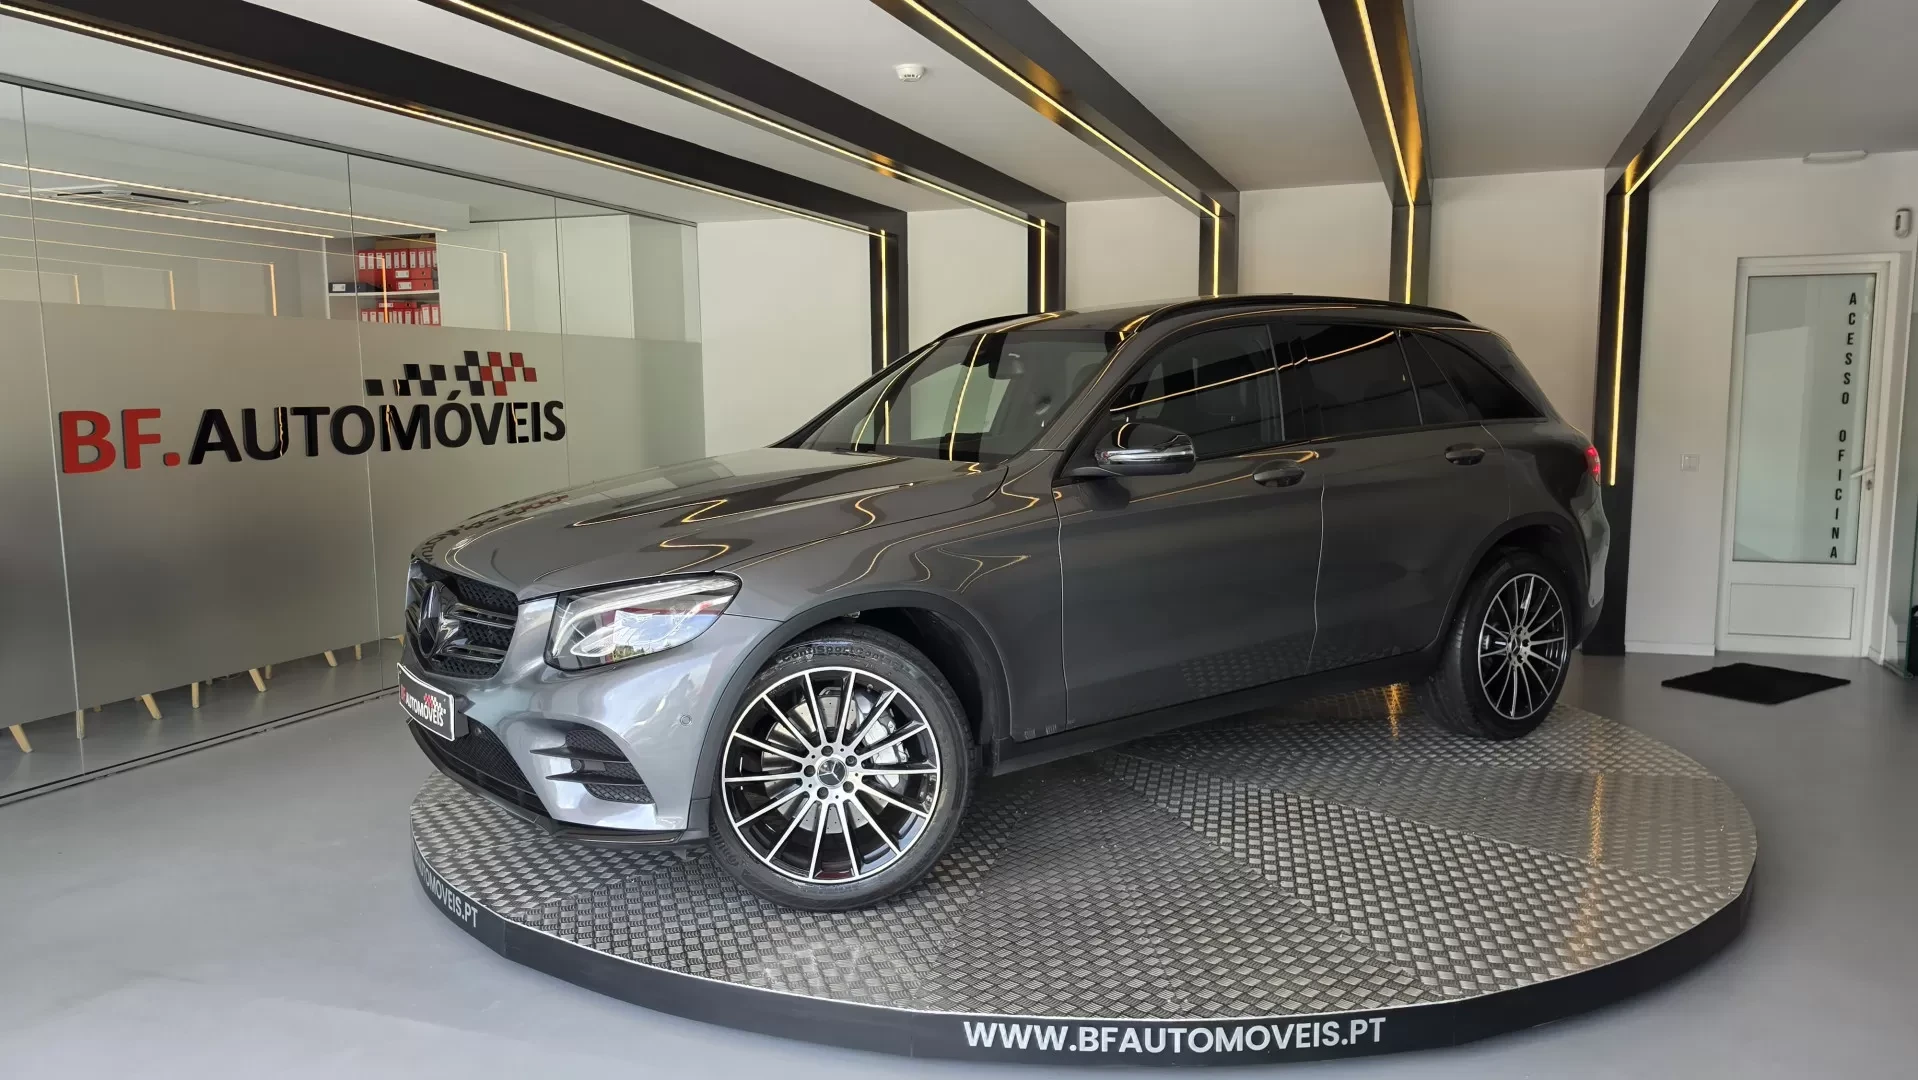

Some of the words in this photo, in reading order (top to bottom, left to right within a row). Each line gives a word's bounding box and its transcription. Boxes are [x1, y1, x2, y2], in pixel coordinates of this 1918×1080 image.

[1842, 292, 1857, 405] ACESSO
[1830, 429, 1847, 559] OFICINA
[962, 1017, 1387, 1053] WWW.BFAUTOMOVEIS.PT
